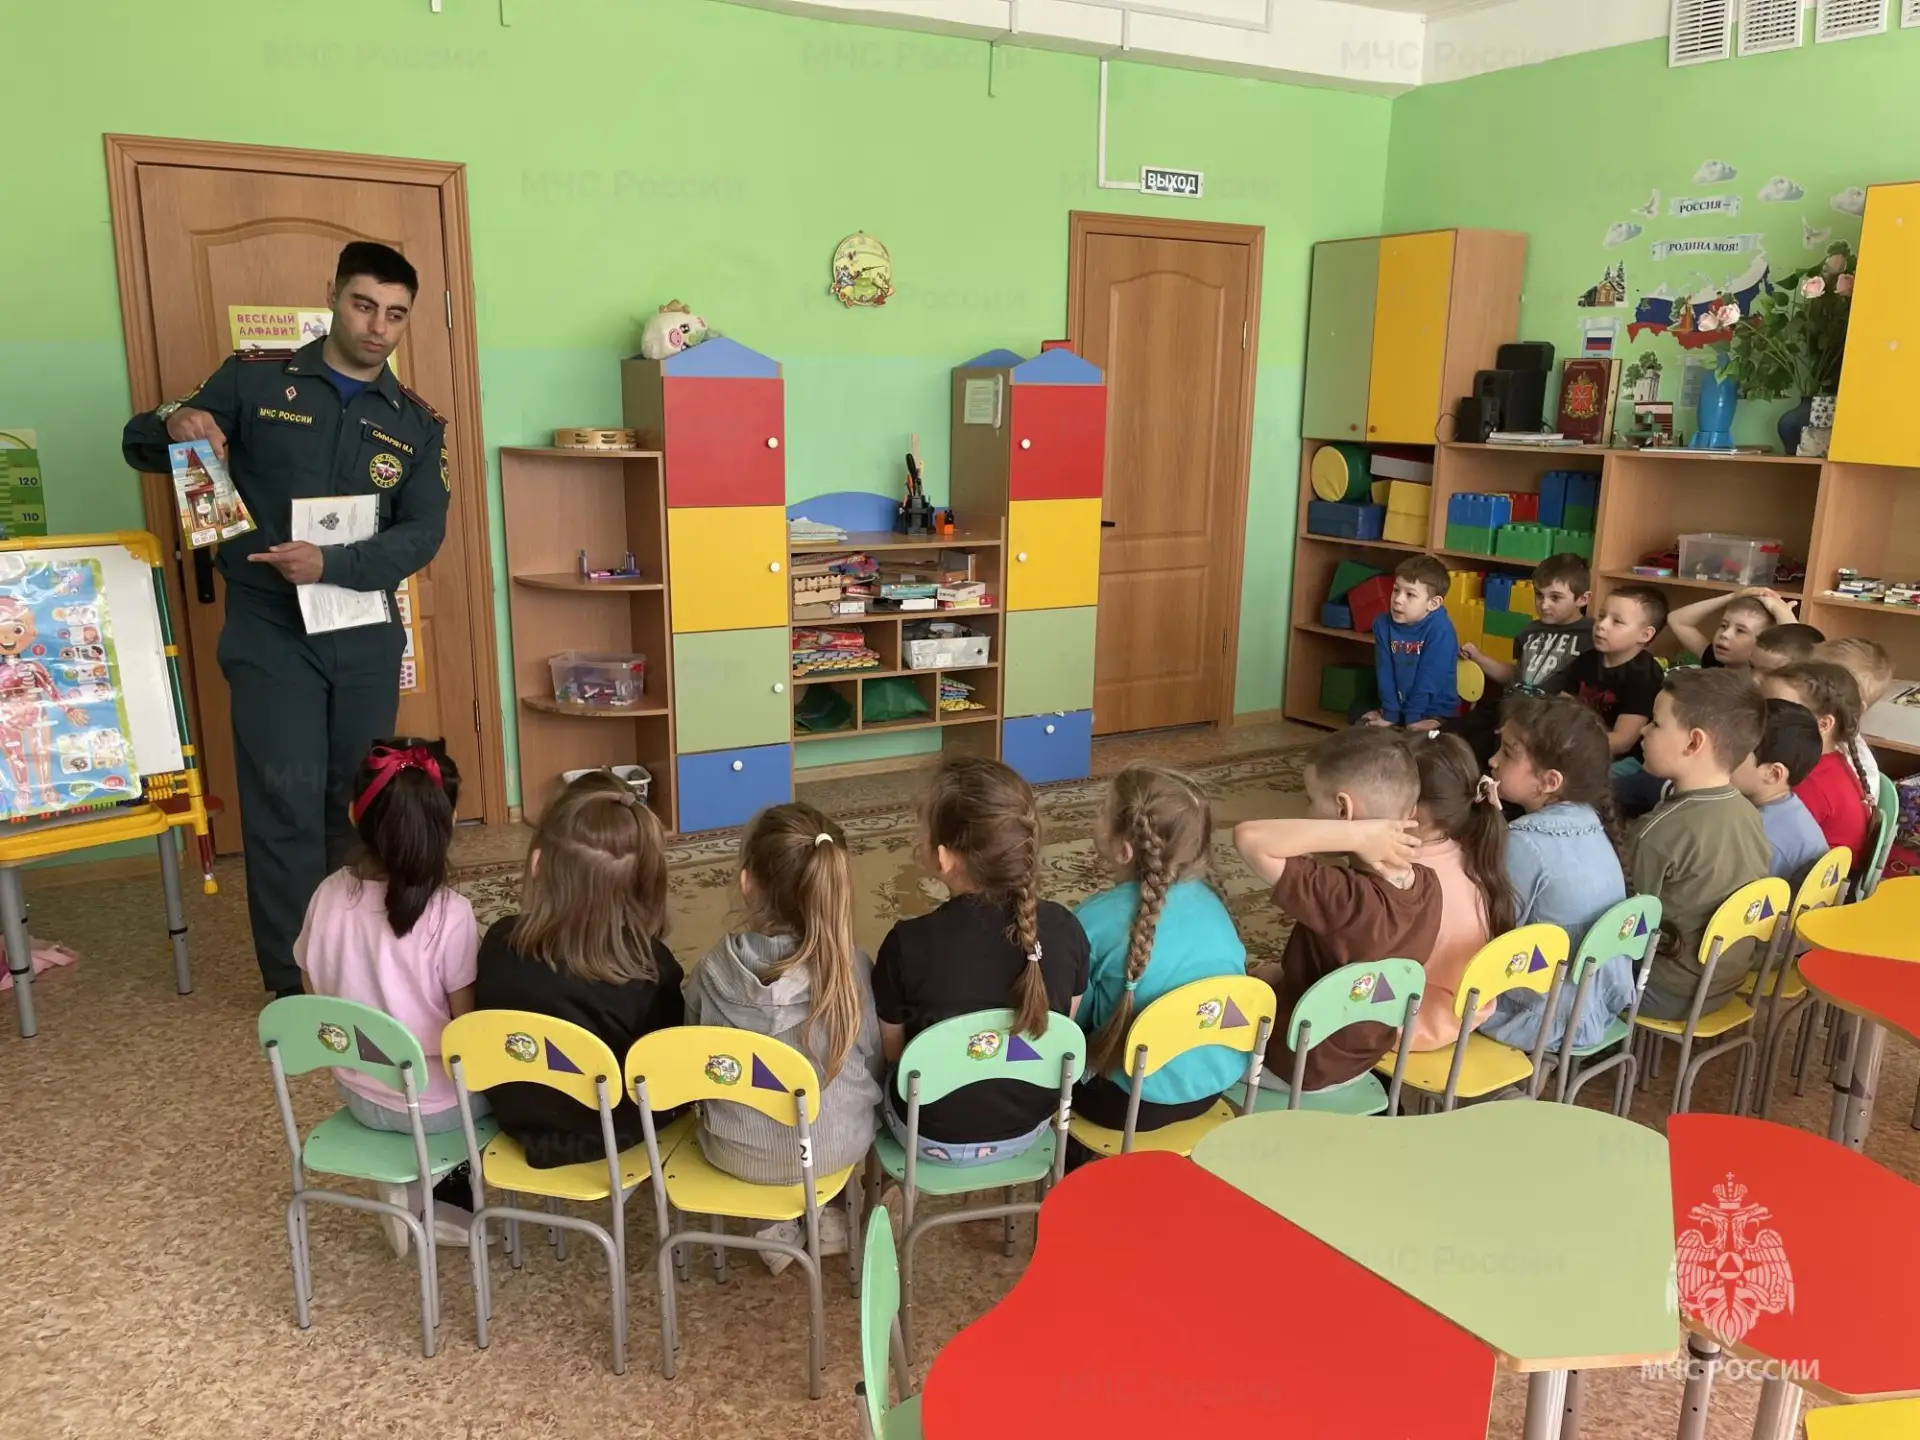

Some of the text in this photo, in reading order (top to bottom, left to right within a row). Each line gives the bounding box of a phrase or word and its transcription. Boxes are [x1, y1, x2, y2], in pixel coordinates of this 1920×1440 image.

[1148, 172, 1196, 191] ВЫХОД
[1679, 200, 1722, 213] РОССИЯ
[1669, 241, 1739, 253] РОДИНА МОЯ!
[239, 325, 296, 336] АЛФАВИТ
[259, 407, 313, 425] МЧС РОССИИ
[18, 476, 38, 486] 120
[22, 512, 39, 522] 110
[1526, 654, 1559, 673] UP
[799, 1144, 808, 1161] 2
